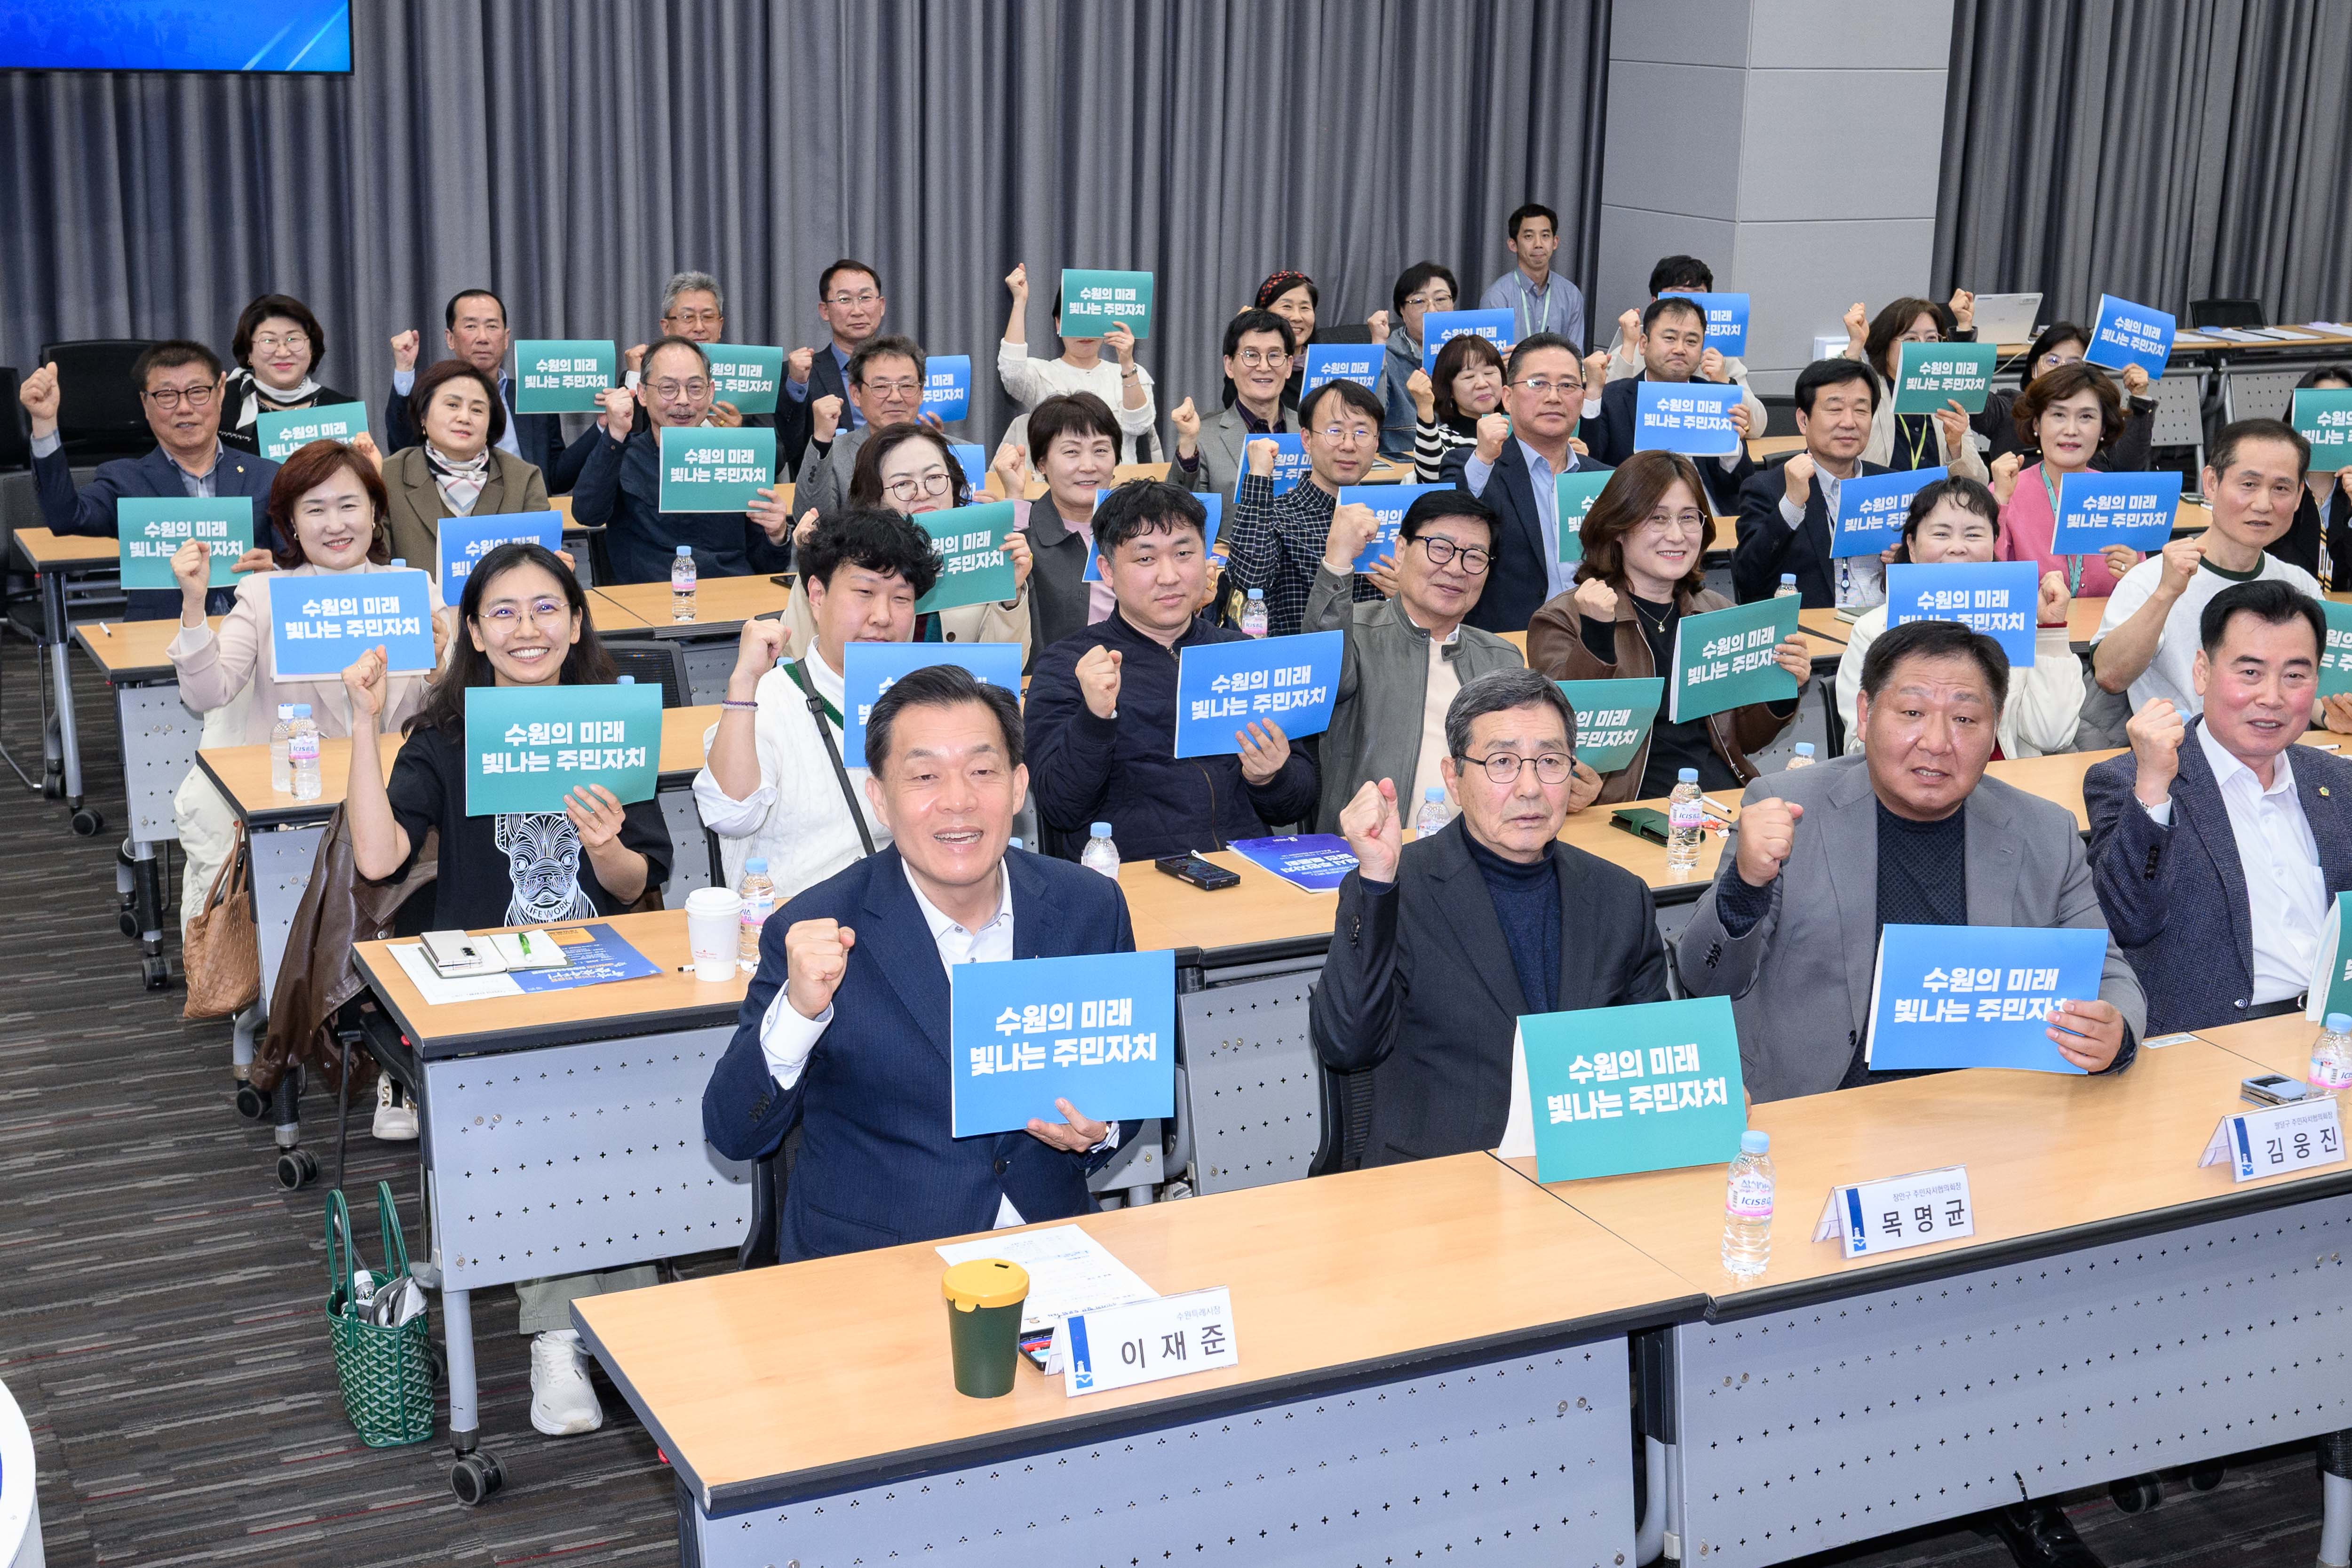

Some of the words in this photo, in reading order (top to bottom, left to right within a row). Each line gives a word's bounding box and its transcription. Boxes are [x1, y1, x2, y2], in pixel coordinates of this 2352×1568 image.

[1080, 287, 1112, 301] 수원의
[1114, 288, 1136, 301] 미래
[1069, 302, 1102, 315] 빛나는
[1104, 302, 1145, 316] 주민자치
[1710, 310, 1732, 322] 미래
[2114, 316, 2142, 334] 수원의
[2142, 324, 2161, 340] 미래
[2100, 328, 2130, 347] 빛나는
[2130, 336, 2166, 357] 주민자치
[536, 359, 571, 373] 수원의
[574, 358, 597, 372] 미래
[709, 363, 736, 376] 원의
[739, 364, 763, 378] 미래
[1321, 362, 1350, 374] 수원의
[1351, 362, 1369, 374] 미래
[1919, 361, 1953, 375] 수원의
[1955, 362, 1978, 375] 미래
[524, 375, 560, 389] 빛나는
[562, 374, 608, 388] 주민자치
[725, 379, 772, 392] 주민자치
[931, 374, 954, 386] 미래
[1906, 377, 1939, 390] 빛나는
[1941, 378, 1986, 391] 주민자치
[922, 388, 964, 404] 주민자치
[1657, 398, 1694, 413] 수원의
[1697, 400, 1722, 414] 미래
[1644, 413, 1681, 428] 빛나는
[1683, 415, 1732, 431] 주민자치
[279, 424, 318, 441] 수원의
[321, 422, 347, 436] 미래
[684, 448, 724, 464] 수원의
[728, 449, 755, 464] 미래
[1274, 454, 1299, 466] 원의
[670, 467, 711, 483] 빛나는
[714, 467, 766, 483] 주민자치
[1859, 495, 1898, 514] 수원의
[2083, 495, 2126, 511] 수원의
[2129, 495, 2157, 509] 미래
[1375, 509, 1403, 526] 원의
[1844, 515, 1883, 532] 빛나는
[2066, 513, 2108, 528] 빛나는
[2111, 511, 2167, 528] 주민자치
[144, 521, 191, 538] 수원의
[196, 521, 227, 537] 미래
[129, 541, 177, 558] 빛나는
[198, 540, 245, 557] 자치
[931, 535, 959, 556] 원의
[962, 530, 991, 550] 미래
[947, 549, 1004, 575] 주민자치
[302, 597, 358, 617] 수원의
[363, 596, 400, 614] 미래
[1917, 590, 1970, 610] 수원의
[1974, 589, 2009, 608] 미래
[285, 621, 342, 640] 빛나는
[346, 617, 420, 637] 주민자치
[1702, 633, 1745, 660] 수원의
[1748, 625, 1775, 648] 미래
[1211, 669, 1269, 693] 수원의
[1274, 665, 1311, 687] 미래
[1687, 661, 1729, 686] 빛나는
[1192, 697, 1248, 720] 빛나는
[1252, 686, 1327, 713] 주민자치
[1594, 709, 1632, 727] 미래
[504, 722, 572, 747] 수원의
[580, 720, 625, 743] 미래
[482, 751, 550, 774] 빛나는
[556, 747, 646, 771] 주민자치
[1923, 967, 2001, 993] 수원의
[2007, 968, 2059, 991] 미래
[995, 1002, 1073, 1036] 수원의
[1081, 998, 1132, 1028] 미래
[1894, 999, 1970, 1023] 빛나는
[970, 1042, 1046, 1076] 빛나는
[1053, 1033, 1156, 1067] 주민자치
[1569, 1049, 1644, 1084] 수원의
[1649, 1043, 1700, 1075] 미래
[1547, 1090, 1623, 1124] 빛나는
[1629, 1077, 1728, 1115] 주민자치
[1176, 1306, 1221, 1321] 수원특례시장
